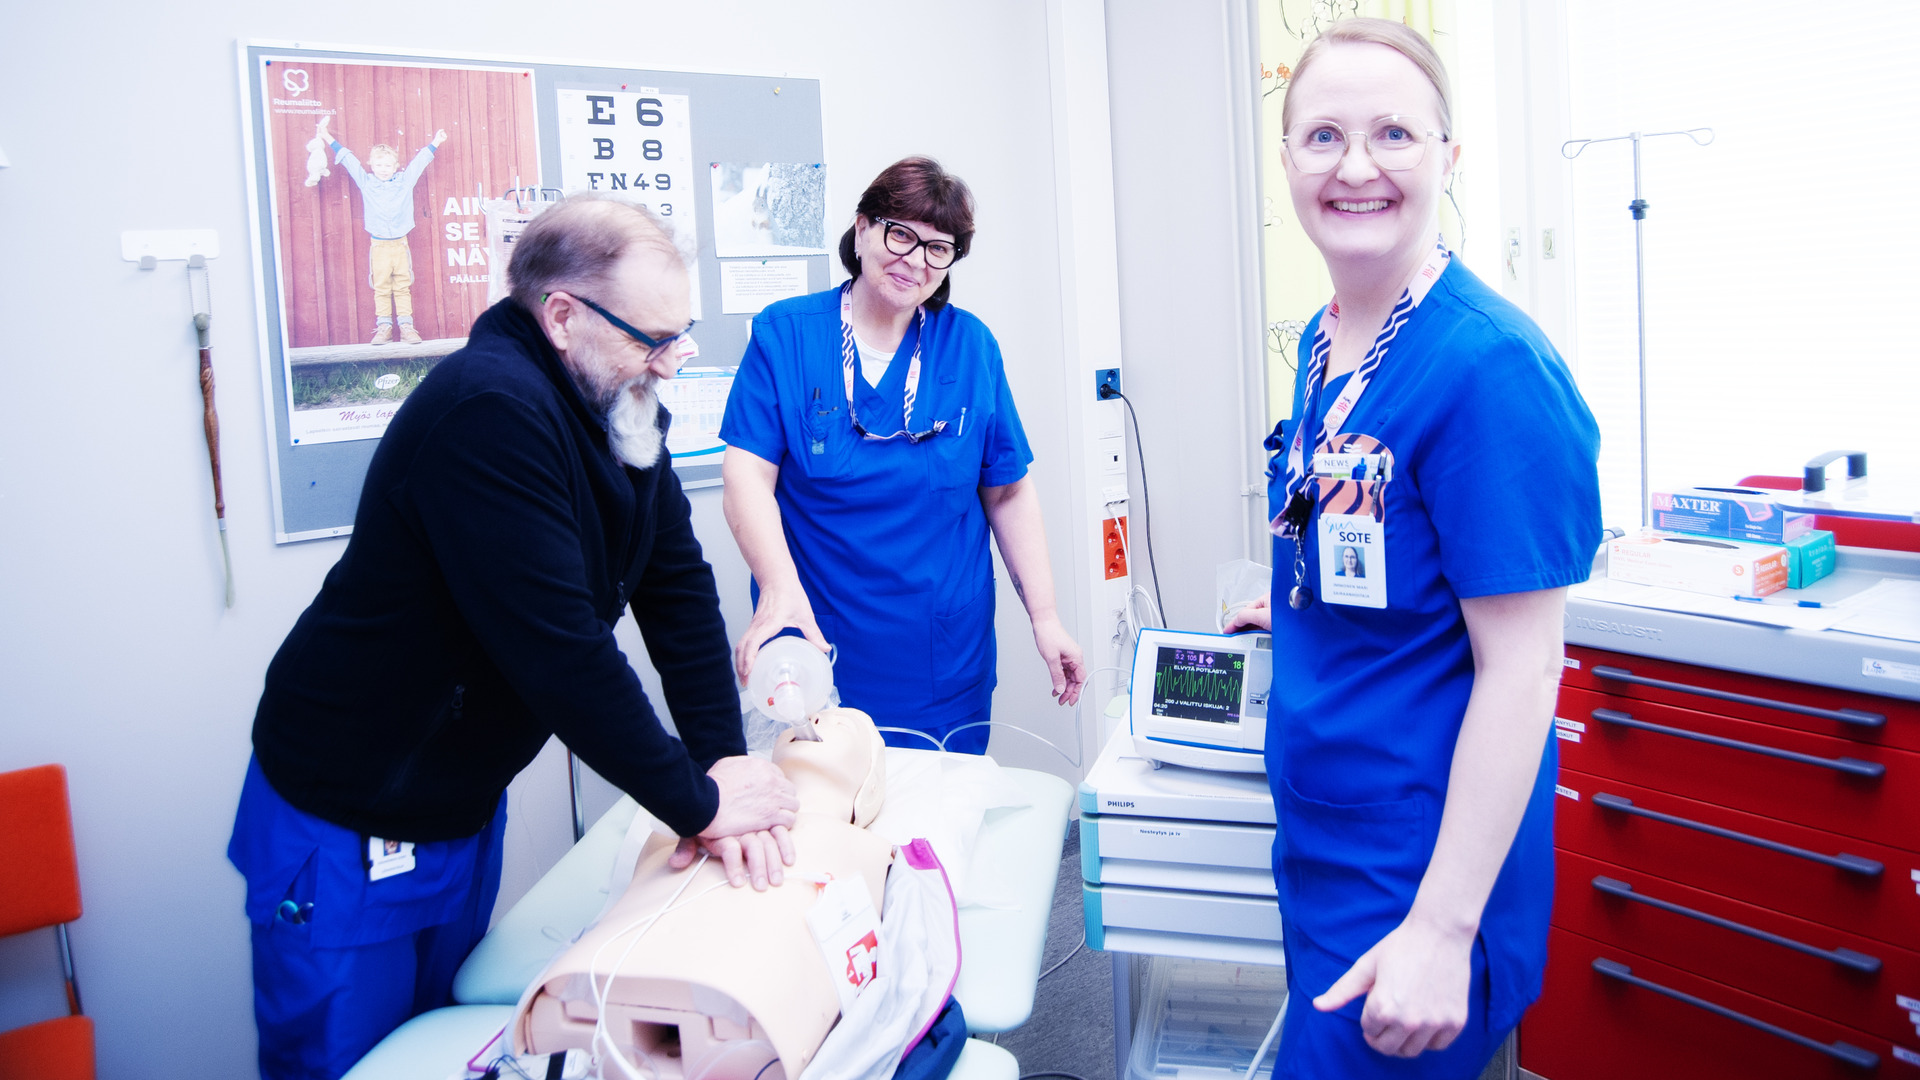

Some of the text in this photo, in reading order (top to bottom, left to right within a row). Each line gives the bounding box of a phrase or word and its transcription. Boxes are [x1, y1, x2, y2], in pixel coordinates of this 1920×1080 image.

[273, 98, 322, 107] Reumaliitto
[586, 95, 664, 127] E 6
[593, 138, 663, 161] B 8
[443, 196, 503, 216] AIN
[660, 203, 673, 216] 3
[445, 222, 480, 241] SE
[450, 274, 491, 285] PÄÄLLE
[377, 376, 399, 390] Pfizer
[339, 410, 371, 422] Myös
[1656, 495, 1721, 513] MAXTER
[1339, 531, 1372, 544] SOTE
[1621, 549, 1651, 558] REGULAR
[1107, 800, 1135, 808] PHILIPS
